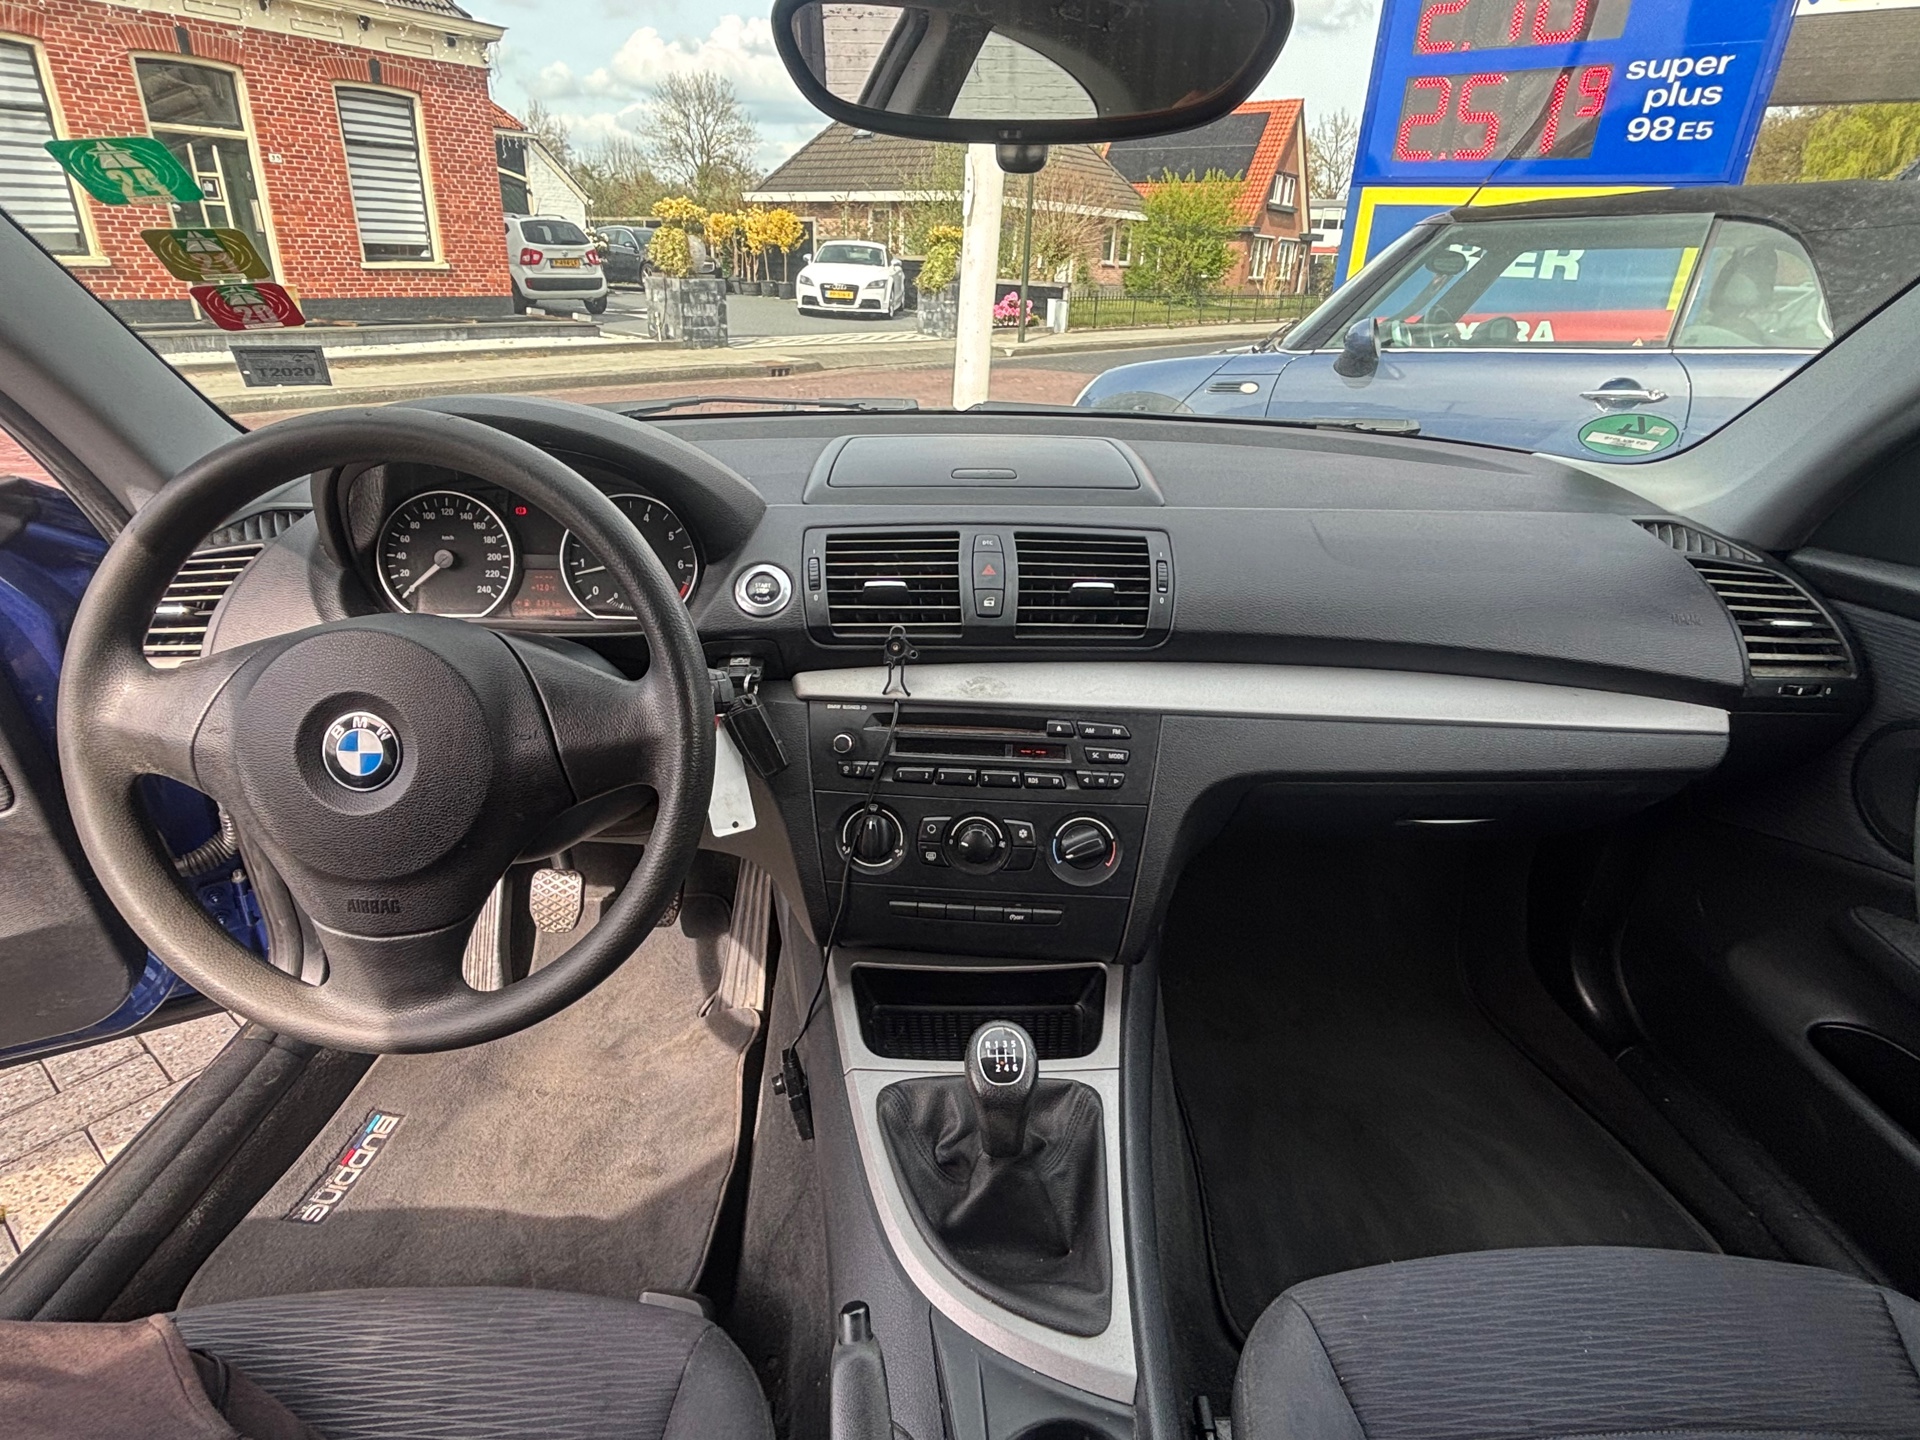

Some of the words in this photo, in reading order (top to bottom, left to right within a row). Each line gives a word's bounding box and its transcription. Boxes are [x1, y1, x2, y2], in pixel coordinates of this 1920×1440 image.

[1626, 54, 1736, 84] super
[1642, 81, 1724, 114] plus
[1626, 116, 1676, 142] 98
[1677, 121, 1715, 141] E5
[233, 304, 278, 325] 20
[256, 367, 315, 377] T2020
[422, 511, 436, 520] 100
[441, 507, 454, 516] 120
[460, 512, 473, 520] 140
[643, 512, 650, 523] 4
[409, 521, 420, 529] 80
[473, 521, 486, 530] 160
[400, 535, 410, 543] 60
[483, 536, 497, 544] 180
[668, 531, 675, 541] 5
[396, 552, 407, 560] 40
[487, 553, 502, 561] 200
[580, 558, 585, 568] 1
[677, 560, 684, 570] 6
[400, 569, 410, 577] 20
[485, 570, 500, 578] 220
[476, 585, 492, 594] 240
[592, 586, 599, 596] 0
[331, 716, 393, 742] BMW
[347, 899, 400, 913] AIRBAG
[994, 1040, 999, 1048] 1
[1002, 1040, 1008, 1048] 3
[1010, 1040, 1016, 1048] 5
[995, 1064, 1001, 1072] 2
[1003, 1064, 1010, 1072] 4
[1012, 1064, 1019, 1072] 6
